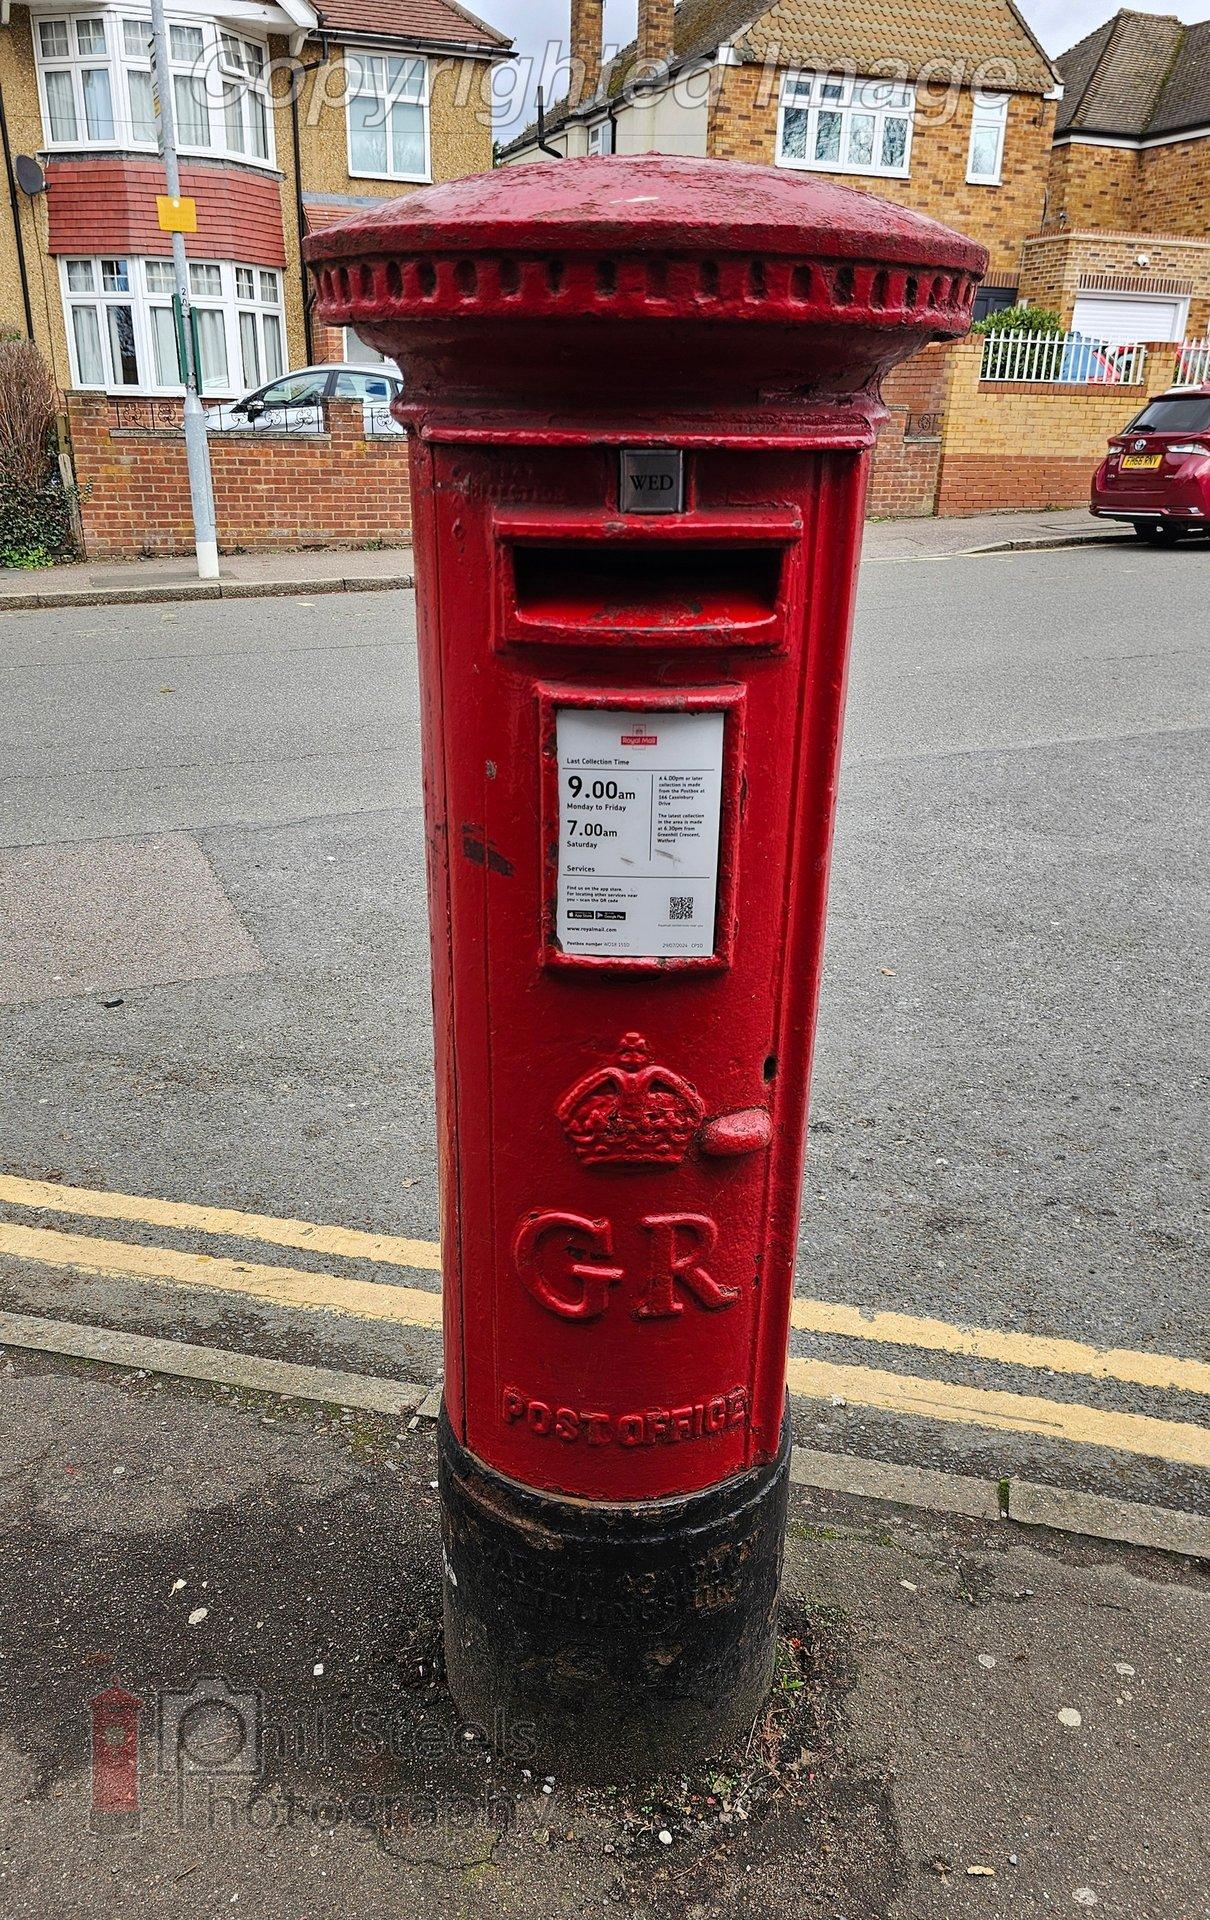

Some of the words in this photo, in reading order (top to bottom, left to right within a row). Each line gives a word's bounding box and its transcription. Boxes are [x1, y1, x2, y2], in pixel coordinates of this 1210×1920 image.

[629, 474, 674, 490] WED
[622, 737, 641, 745] Royal
[568, 775, 636, 800] 9.00am
[566, 803, 594, 811] Monday
[604, 804, 627, 812] Friday
[567, 820, 618, 837] 7.00am
[566, 840, 598, 848] Saturday
[502, 1385, 614, 1446] POST
[618, 1385, 748, 1446] OFFICE
